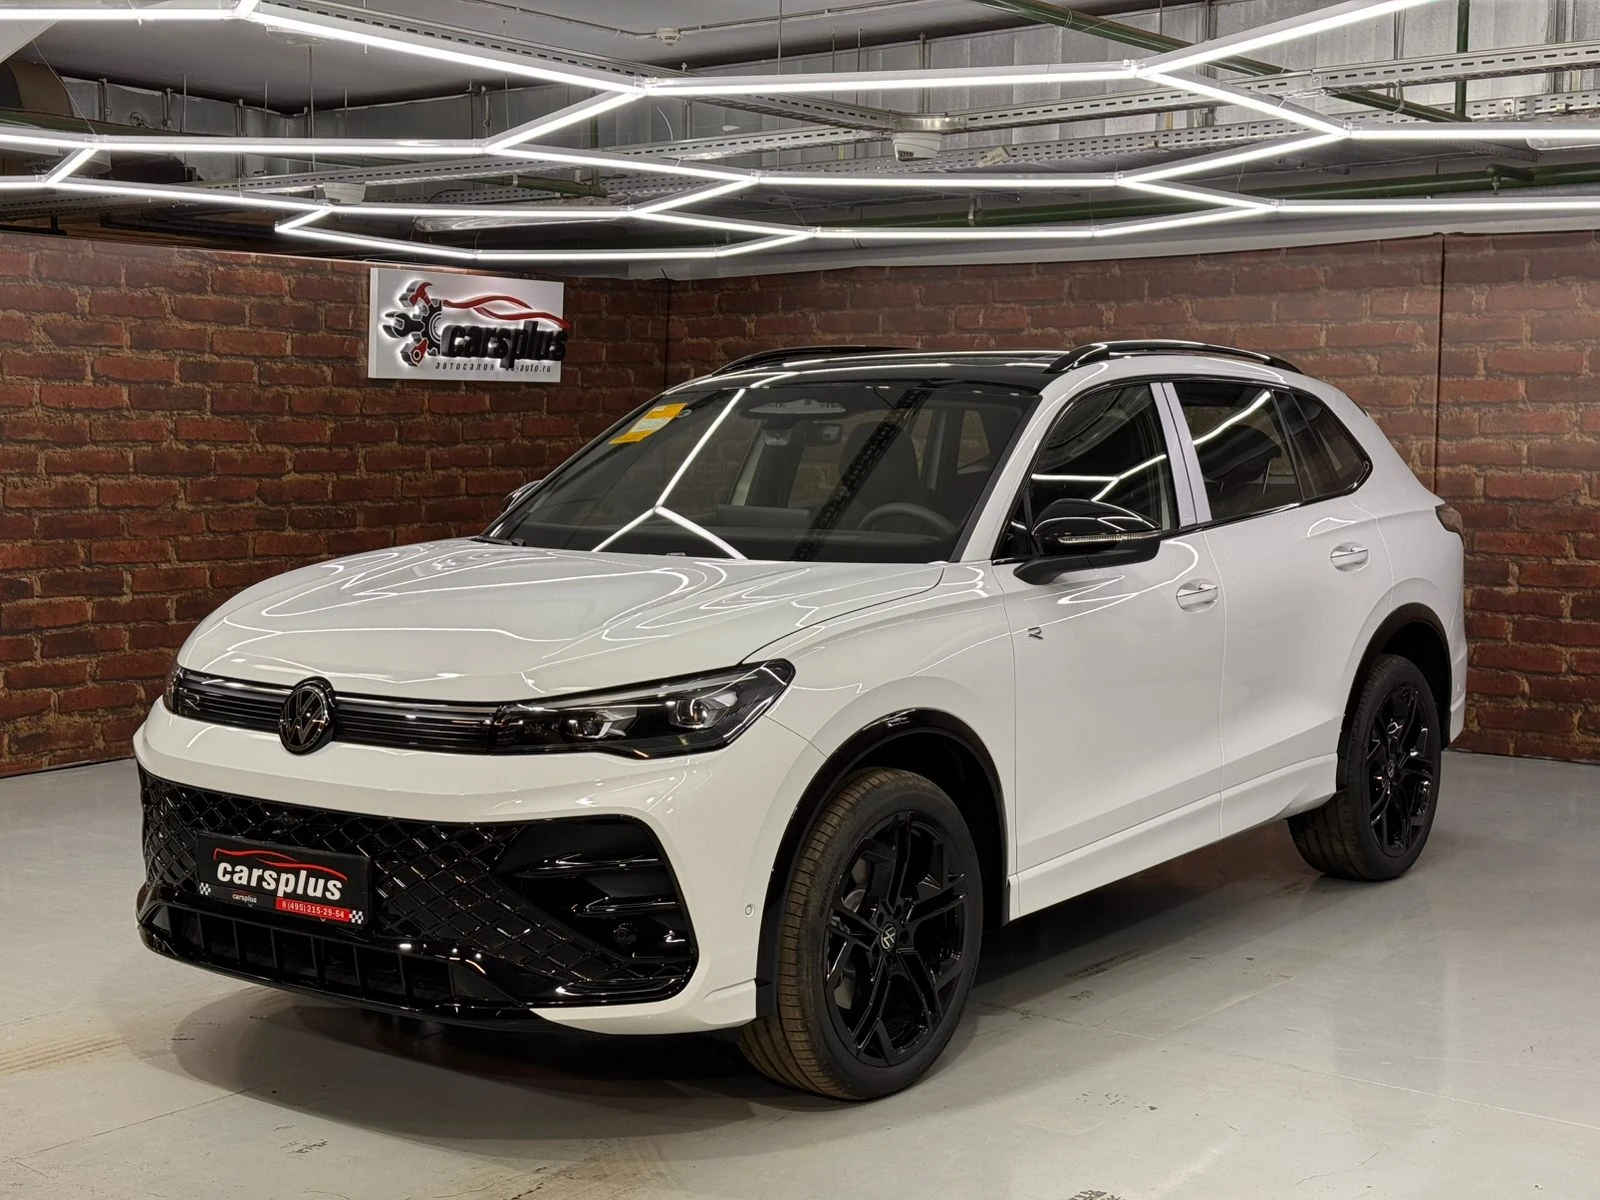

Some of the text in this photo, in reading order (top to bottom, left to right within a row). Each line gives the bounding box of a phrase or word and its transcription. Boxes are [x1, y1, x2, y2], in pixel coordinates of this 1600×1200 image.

[441, 320, 567, 368] carsplus
[505, 364, 552, 373] -auto.ru
[217, 862, 343, 900] carsplus
[232, 893, 257, 903] carsplus
[306, 905, 345, 919] 215-29-54
